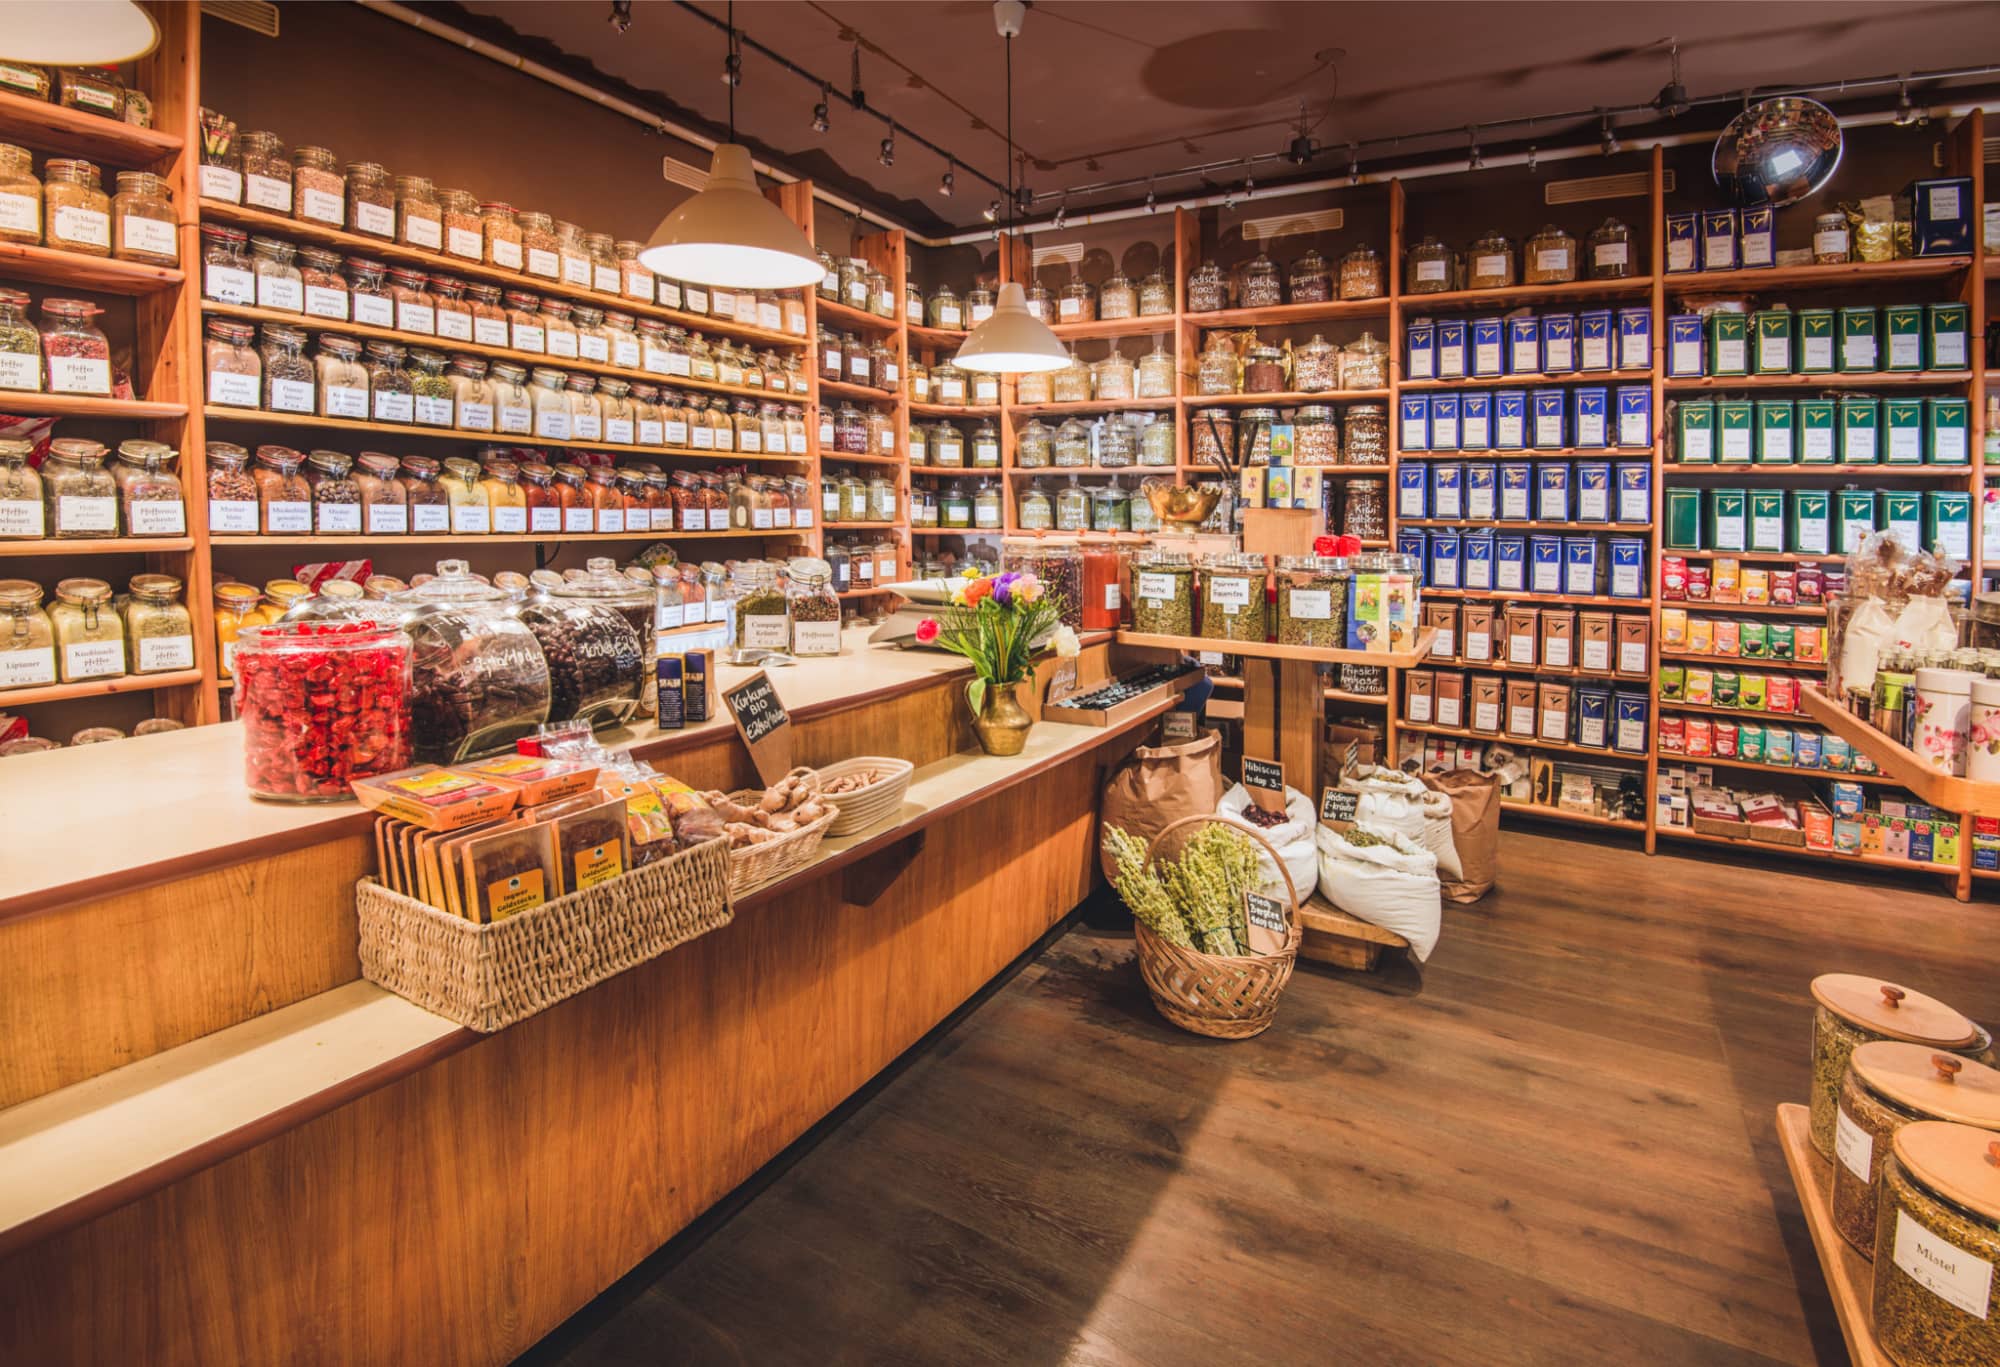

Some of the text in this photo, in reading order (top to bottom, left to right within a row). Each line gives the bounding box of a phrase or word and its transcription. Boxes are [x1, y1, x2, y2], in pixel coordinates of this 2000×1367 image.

[748, 699, 769, 716] BIO
[1244, 759, 1282, 777] Hibiscus
[587, 857, 610, 870] Ingwer
[503, 888, 529, 903] Ingwer
[1915, 1242, 1957, 1276] Mistel
